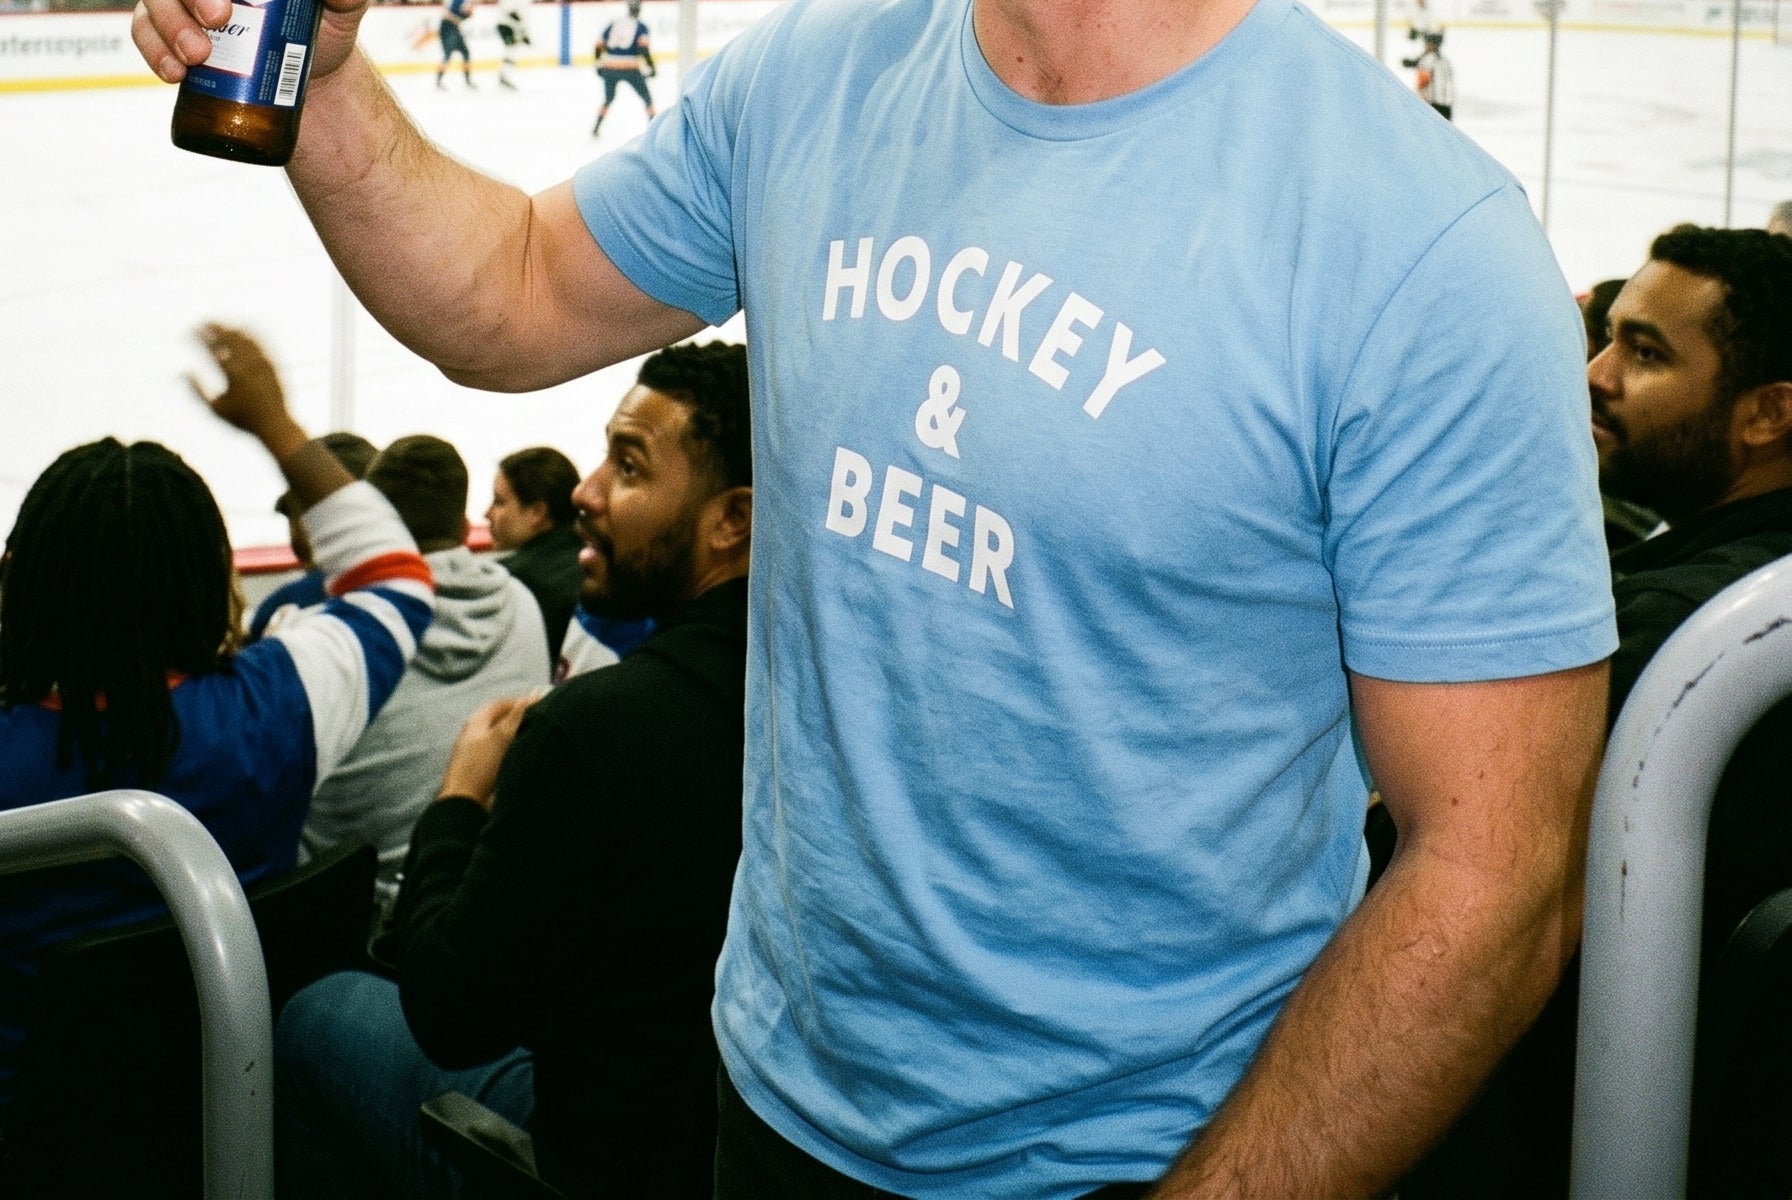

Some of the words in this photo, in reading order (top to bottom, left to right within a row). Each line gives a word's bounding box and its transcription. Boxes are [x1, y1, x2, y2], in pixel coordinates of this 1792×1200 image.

[822, 235, 1167, 420] HOCKEY
[915, 364, 967, 460] &
[825, 446, 1015, 610] BEER
